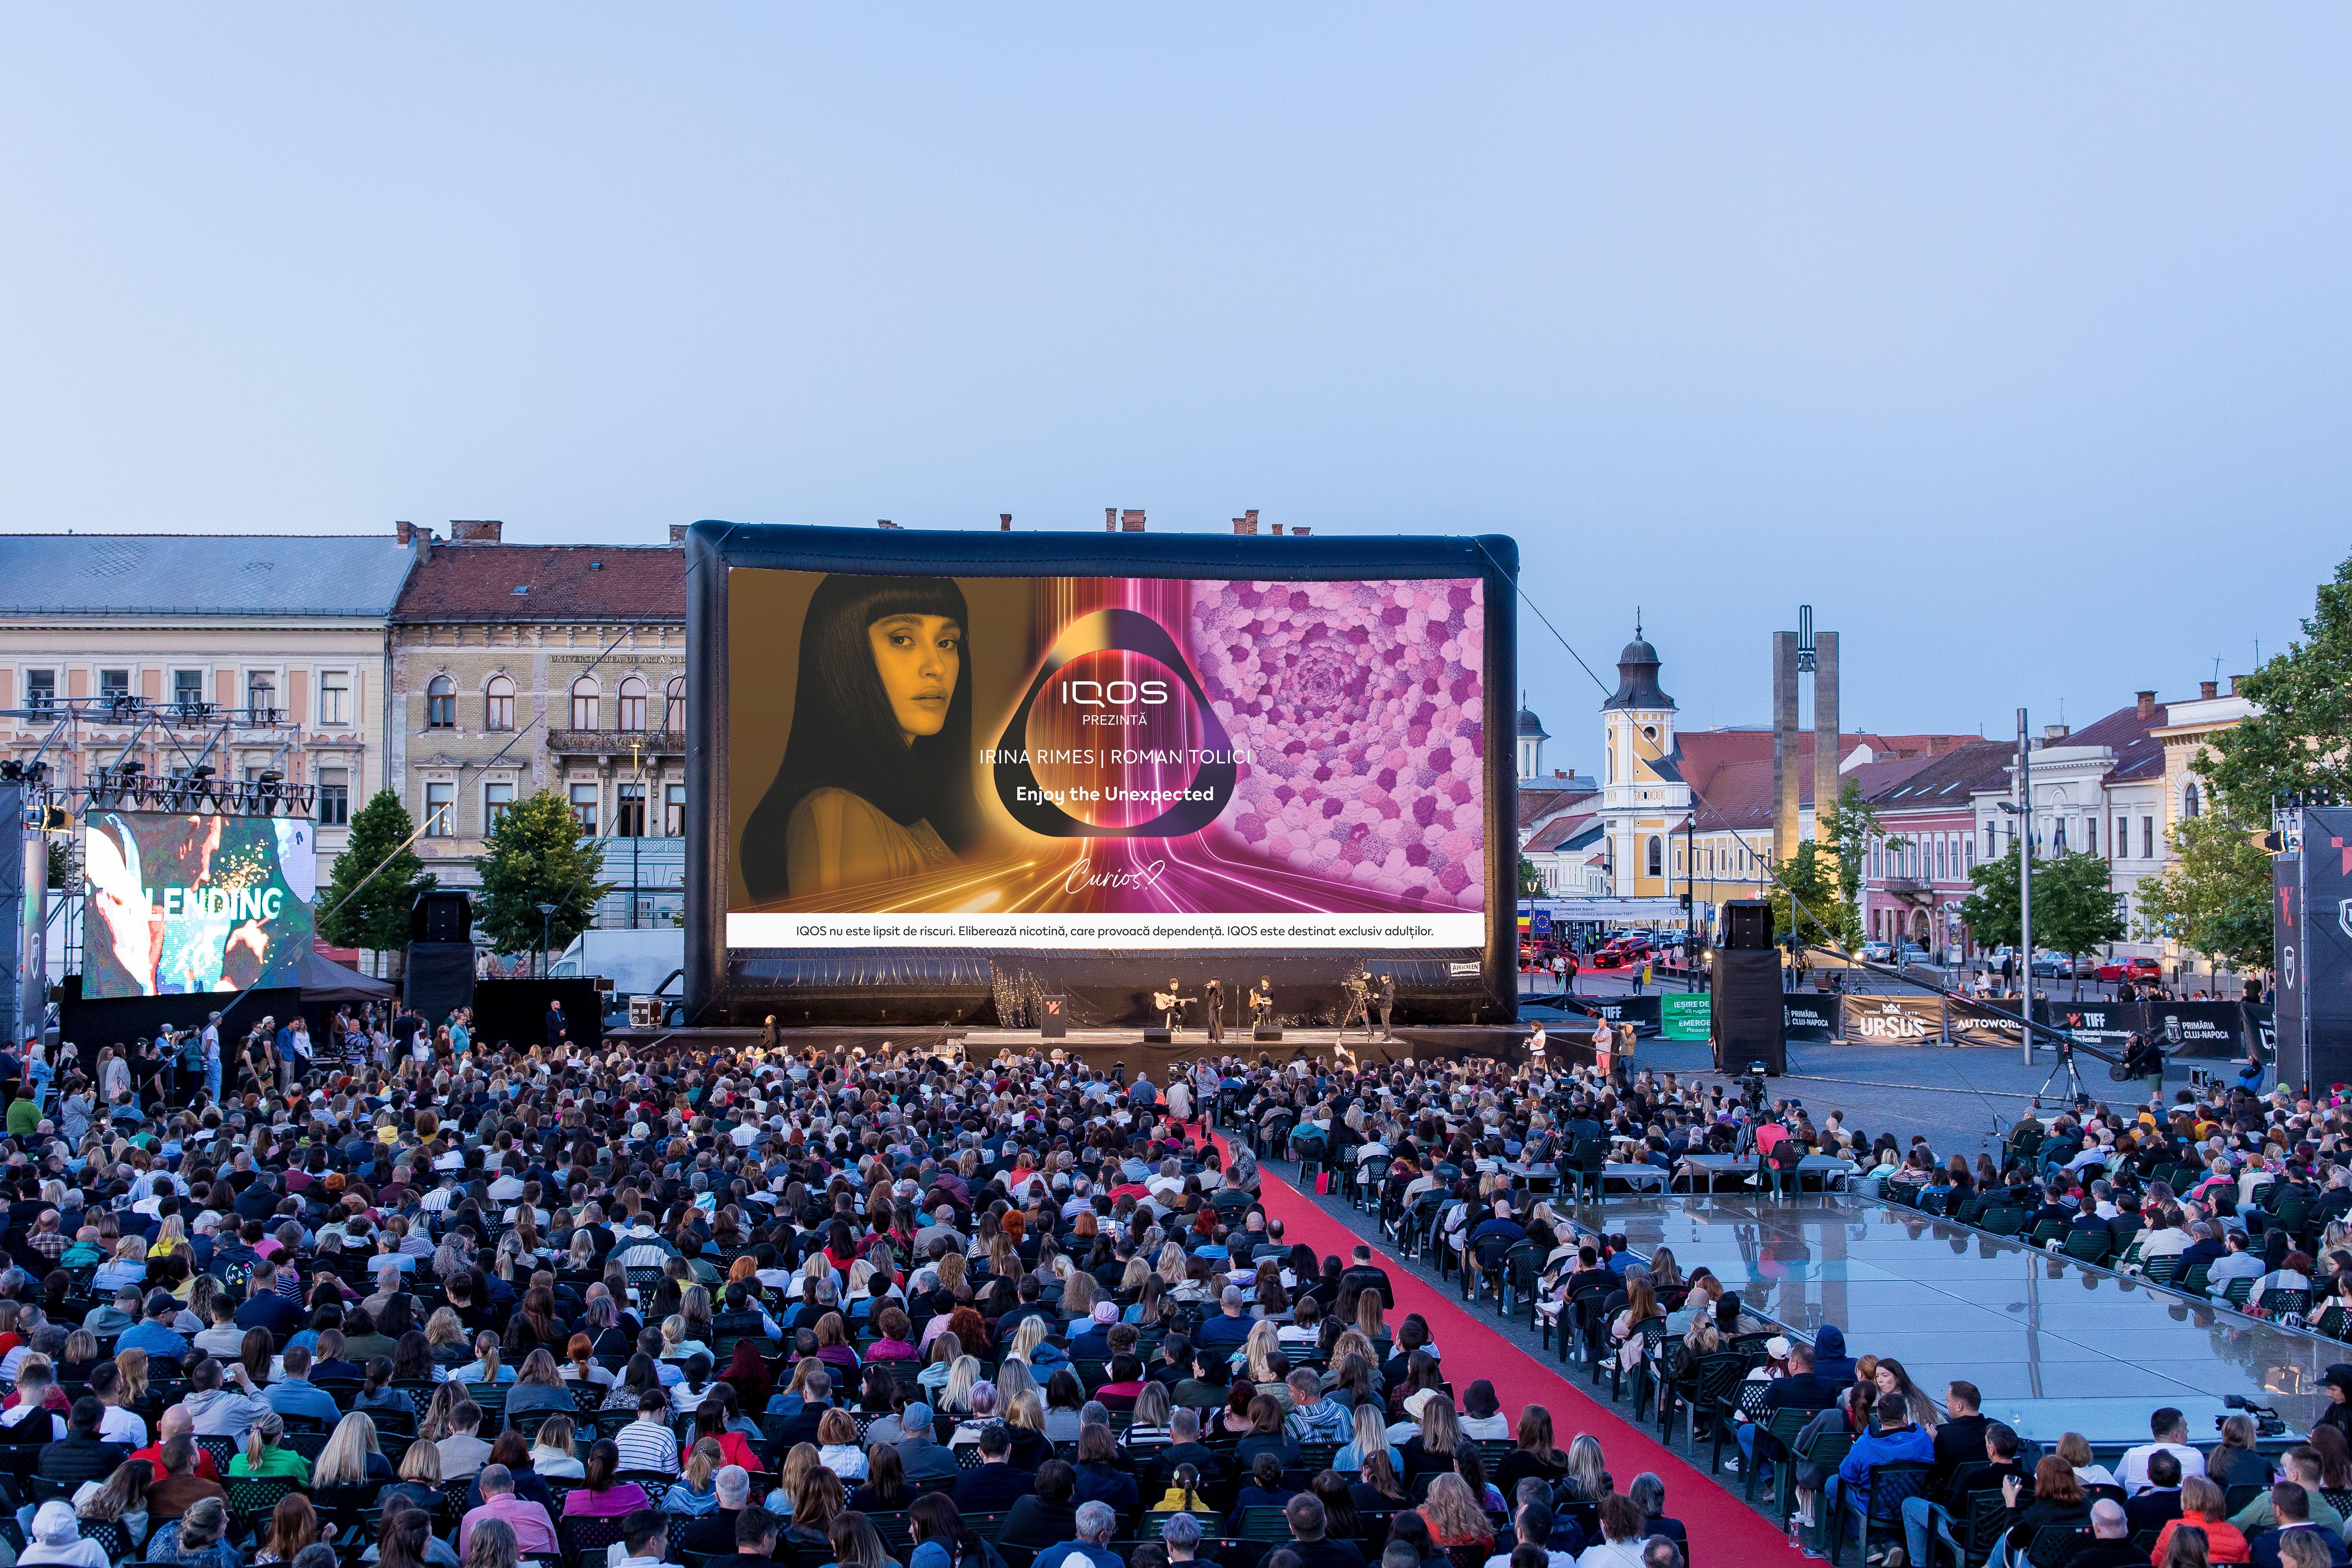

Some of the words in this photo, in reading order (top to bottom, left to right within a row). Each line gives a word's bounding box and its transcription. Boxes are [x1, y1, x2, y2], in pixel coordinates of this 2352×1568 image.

[1063, 681, 1168, 708] IQOS
[1082, 712, 1147, 725] PREZINTĂ
[980, 750, 1031, 764] IRINA
[1038, 750, 1094, 764] RIMES
[1112, 750, 1183, 764] ROMAN
[1188, 750, 1250, 764] TOLICI
[1017, 786, 1065, 806] Enjoy
[1070, 786, 1100, 801] the
[1106, 786, 1214, 806] Unexpected
[144, 887, 284, 921] LENDING
[797, 926, 827, 936] IQOS
[846, 927, 871, 936] este
[874, 925, 900, 939] lipsit
[903, 925, 917, 936] de
[920, 926, 956, 936] riscuri.
[959, 925, 1016, 936] Eliberează
[1020, 926, 1068, 938] nicotină,
[1098, 926, 1149, 939] provoacă
[1153, 925, 1224, 939] dependență.
[1228, 926, 1257, 936] IQOS
[1260, 927, 1285, 936] este
[1288, 925, 1336, 936] destinat
[1339, 925, 1382, 936] exclusiv
[1385, 925, 1434, 939] adulților.
[2286, 956, 2293, 970] BT
[1601, 1006, 1621, 1018] TIFF
[1674, 1001, 1698, 1009] IEȘIRE
[1791, 1009, 1818, 1018] PRIMĂRIA
[2083, 1013, 2105, 1027] TIFF
[1793, 1018, 1829, 1027] CLUJ-NAPOCA
[1860, 1016, 1926, 1038] URSUS
[1957, 1018, 2023, 1029] AUTOWORL
[2182, 1020, 2215, 1030] PRIMĂRIA
[2184, 1031, 2229, 1039] CLUJ-NAPOCA
[228, 1266, 255, 1281] MAU
